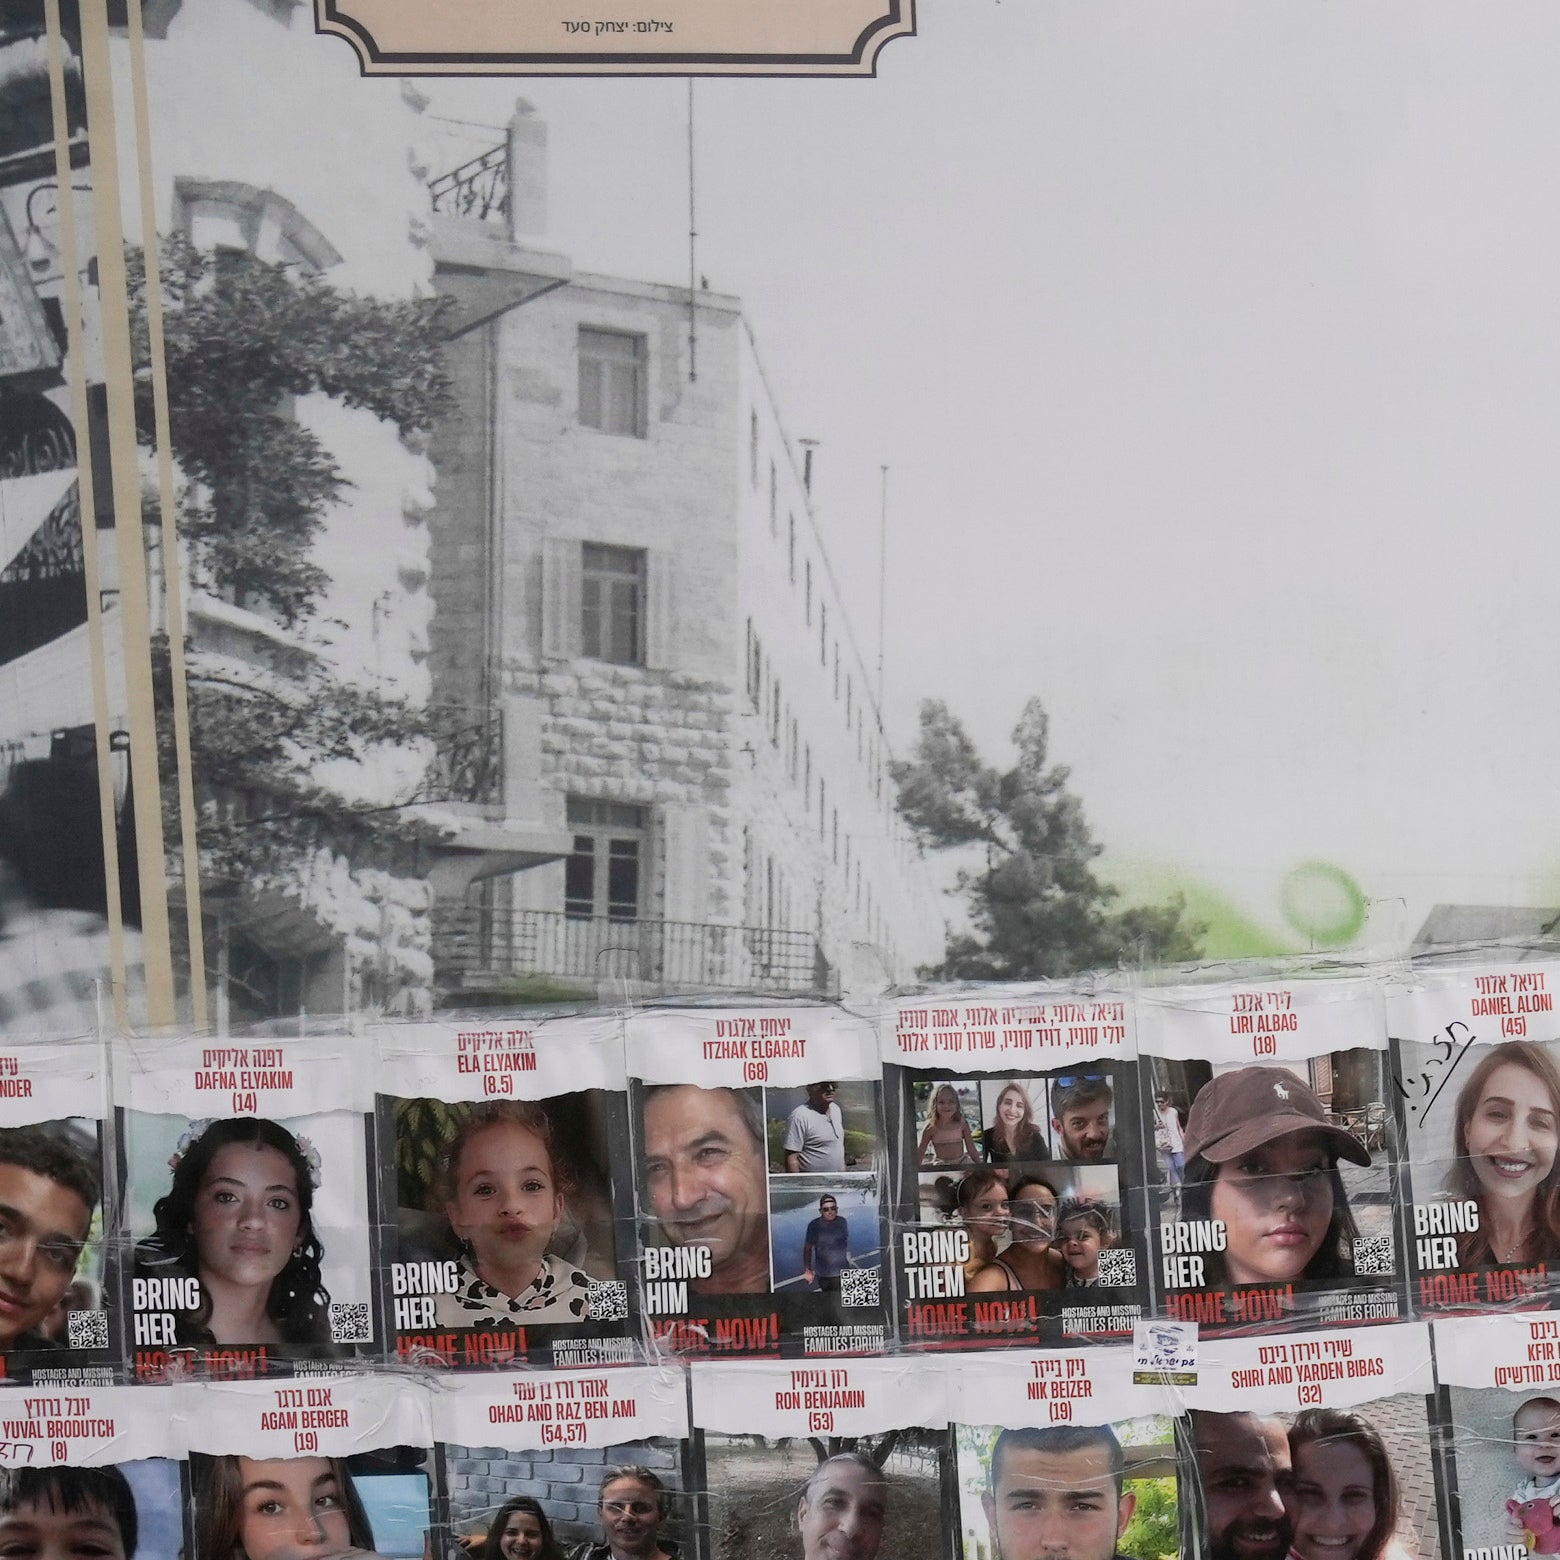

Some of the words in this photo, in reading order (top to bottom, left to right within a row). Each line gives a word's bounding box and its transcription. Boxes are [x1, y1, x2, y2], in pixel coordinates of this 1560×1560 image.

[561, 21, 591, 33] סעד
[595, 21, 628, 37] יצחק
[632, 19, 673, 33] צילום:
[1472, 996, 1515, 1017] DANIEL
[1518, 993, 1553, 1013] ALONI
[1230, 1015, 1254, 1034] LIRI
[1257, 1013, 1299, 1033] ALBAG
[203, 1049, 249, 1069] אליקים
[253, 1048, 283, 1068] דפנה
[703, 1040, 748, 1060] ITZHAK
[751, 1038, 806, 1059] ELGARAT
[457, 1051, 481, 1073] ELA
[483, 1052, 537, 1072] ELYAKIM
[195, 1071, 237, 1090] DAFNA
[240, 1070, 293, 1090] ELYAKIM
[232, 1092, 258, 1112] (14)
[902, 1230, 970, 1264] BRING
[904, 1265, 966, 1300] THEM
[132, 1277, 201, 1311] BRING
[134, 1312, 178, 1345] HER
[1527, 1342, 1555, 1361] KFIR
[1231, 1368, 1265, 1389] SHIRI
[1268, 1365, 1293, 1385] AND
[1295, 1361, 1345, 1382] YARDEN
[1347, 1357, 1385, 1378] BIBAS
[276, 1389, 304, 1408] ברגר
[307, 1388, 332, 1407] אגם
[776, 1389, 801, 1410] RON
[804, 1388, 865, 1409] BENJAMIN
[1027, 1382, 1048, 1400] NIK
[1050, 1378, 1093, 1399] BEIZER
[261, 1411, 299, 1431] AGAM
[301, 1409, 349, 1429] BERGER
[489, 1404, 524, 1424] OHAD
[527, 1400, 553, 1422] AND
[556, 1400, 582, 1420] RAZ
[584, 1400, 609, 1420] BEN
[612, 1399, 636, 1418] AMI
[809, 1411, 834, 1431] (53)
[1049, 1401, 1072, 1421] (19)
[2, 1418, 44, 1440] YUVAL
[47, 1418, 115, 1439] BRODUTCH
